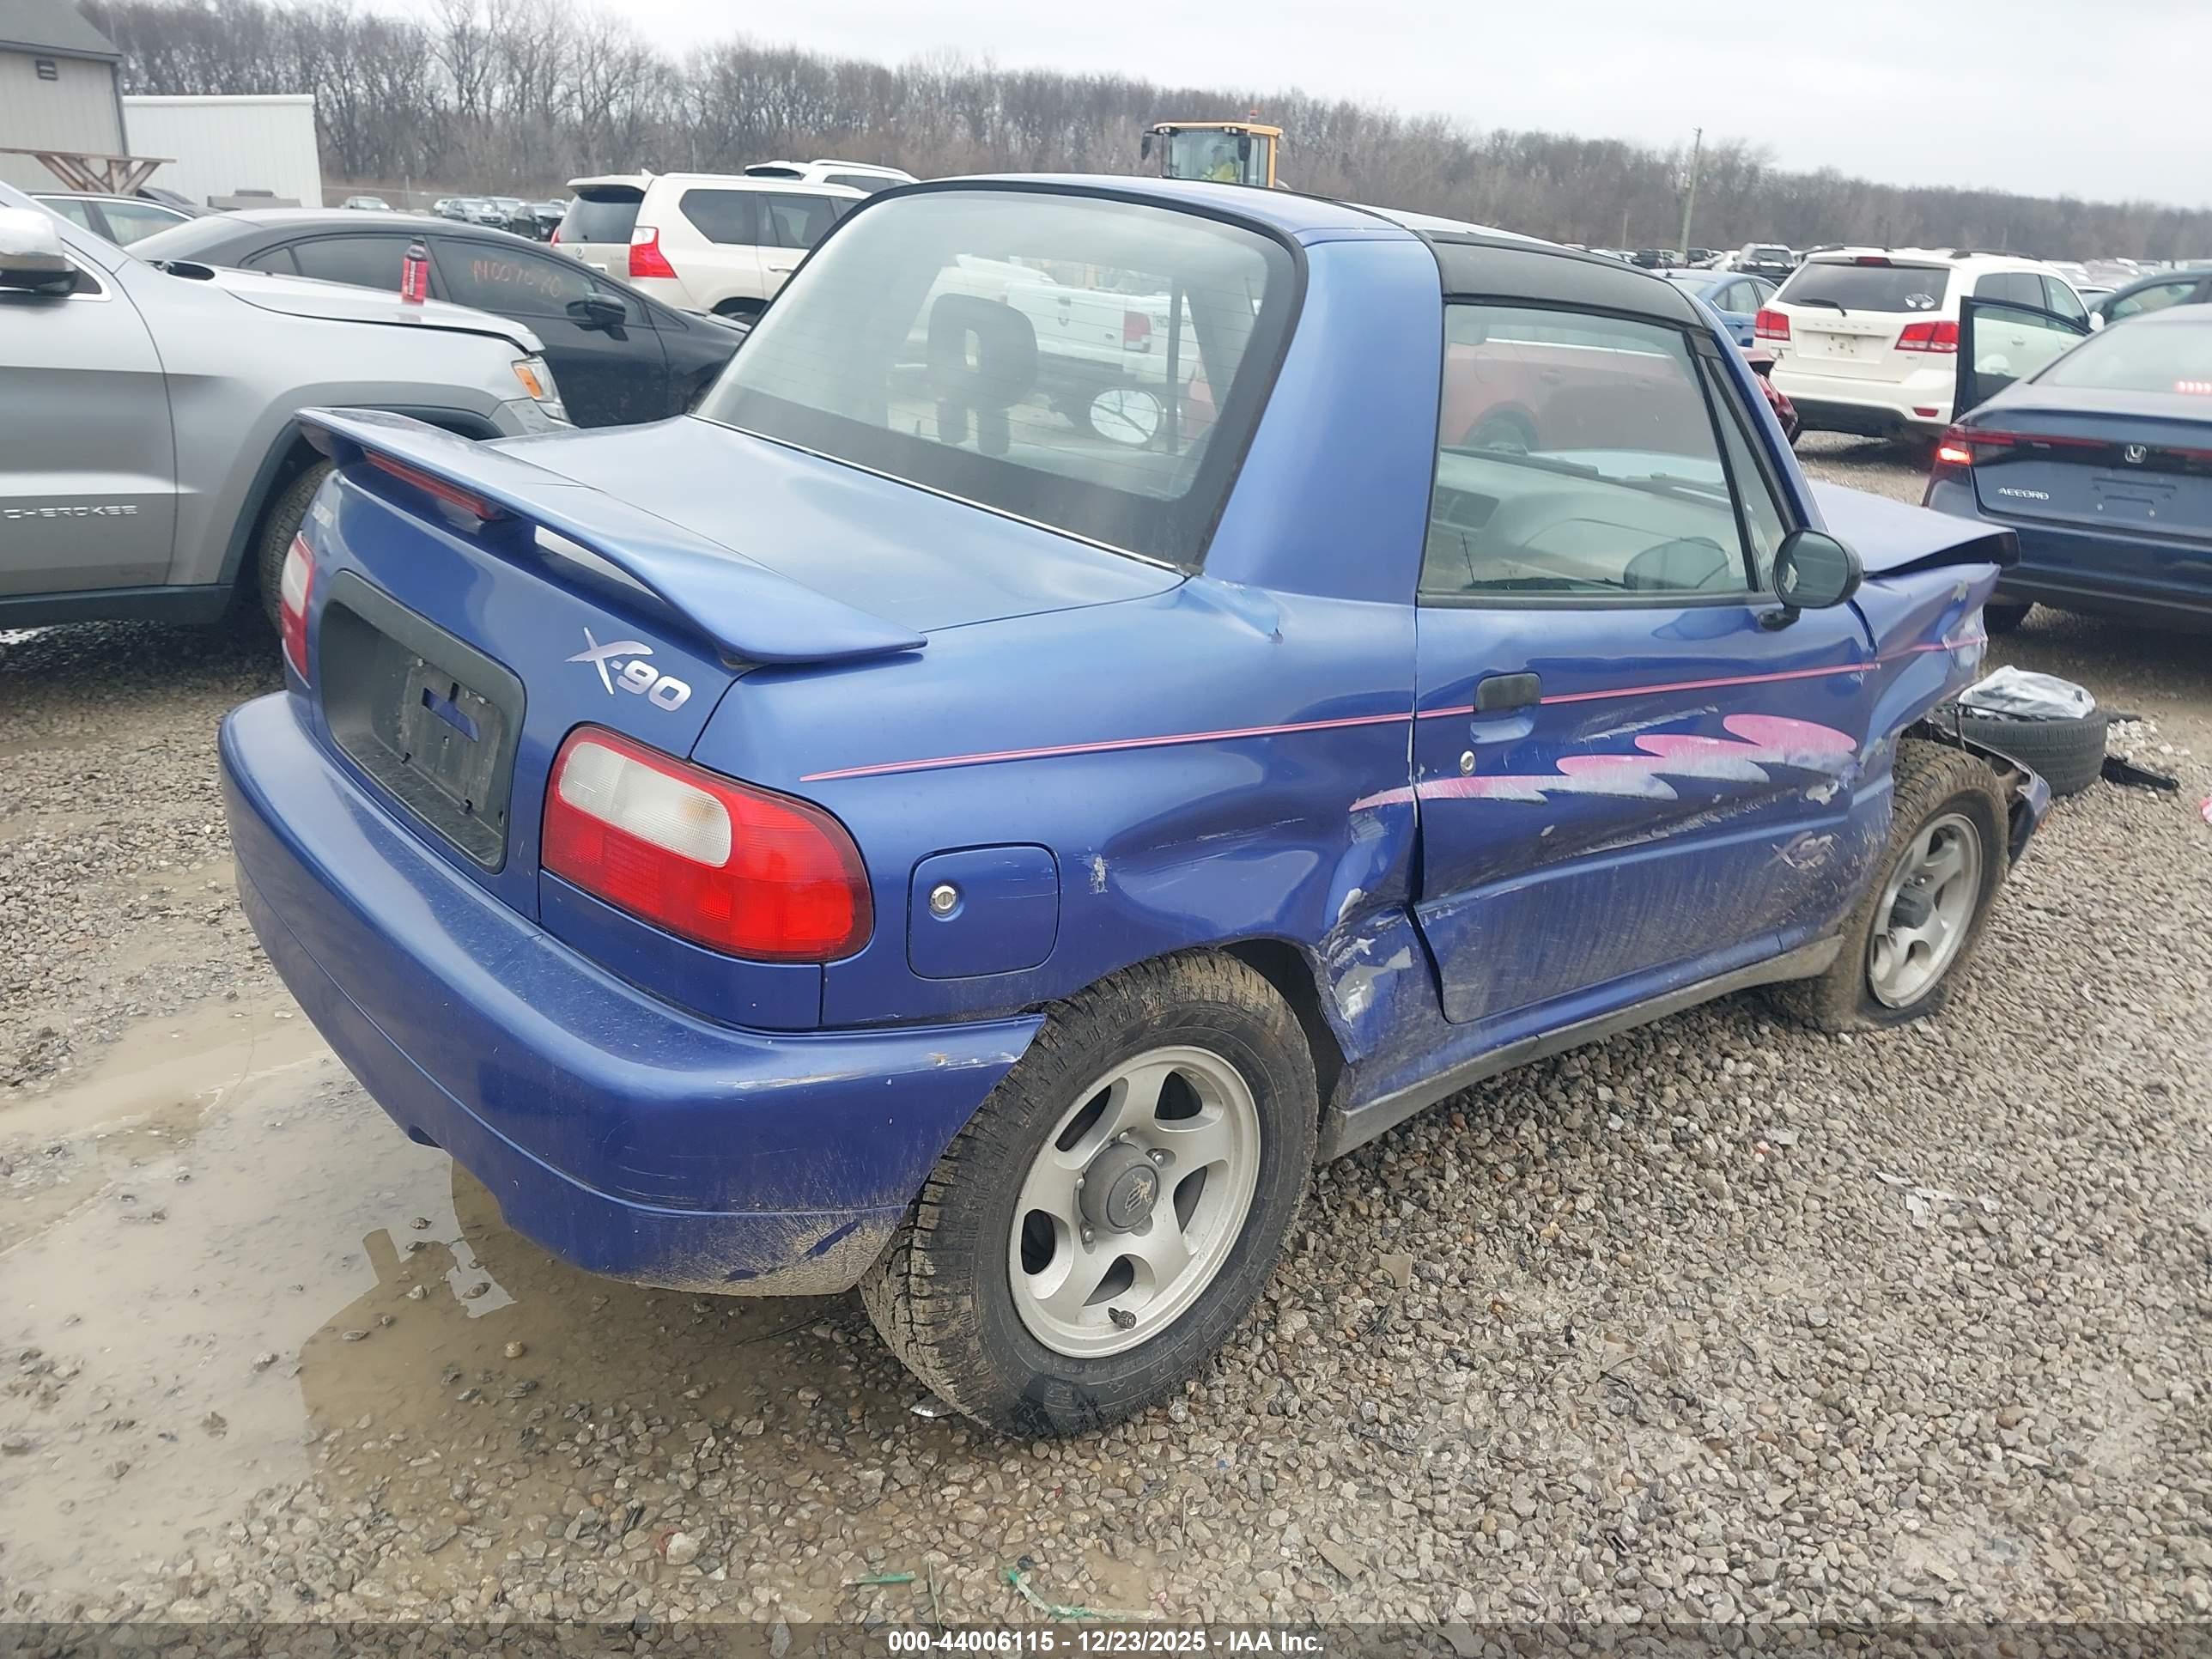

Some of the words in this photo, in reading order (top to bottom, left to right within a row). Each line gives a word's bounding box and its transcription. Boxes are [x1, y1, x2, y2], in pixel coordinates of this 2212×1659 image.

[1997, 487, 2051, 501] ACCORD
[3, 505, 138, 519] CHEROKEE
[564, 626, 692, 712] X-90
